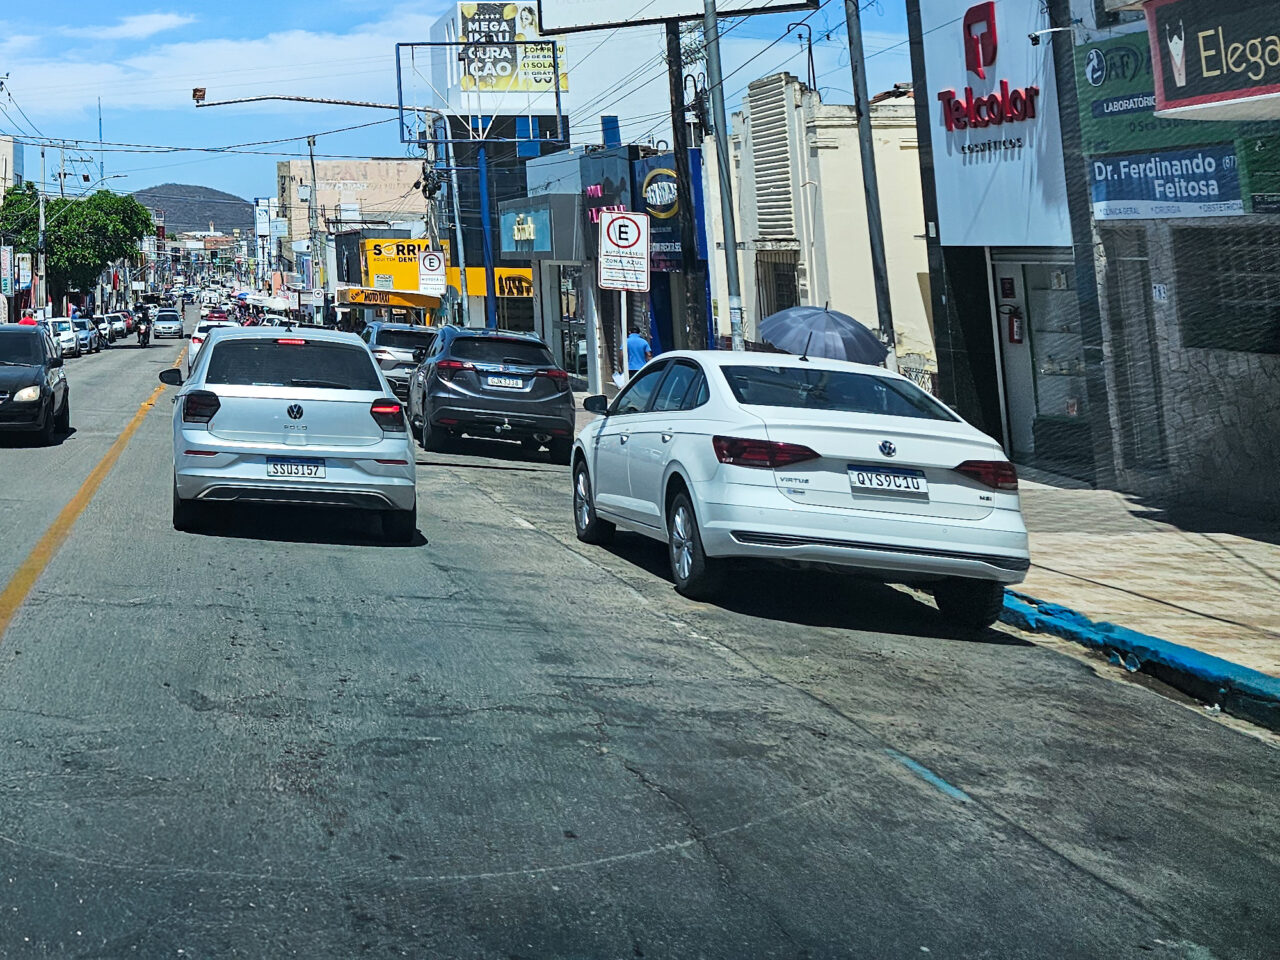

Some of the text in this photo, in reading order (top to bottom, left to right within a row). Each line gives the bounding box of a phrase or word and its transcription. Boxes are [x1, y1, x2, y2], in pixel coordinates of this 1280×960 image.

[468, 21, 510, 32] MEGA
[937, 79, 1040, 132] Telcolor
[1093, 160, 1118, 181] Dr.
[1120, 153, 1216, 179] Ferdinando
[1154, 179, 1220, 198] Feitosa
[618, 224, 629, 241] E
[429, 258, 436, 268] E
[779, 476, 810, 484] VIRTUS
